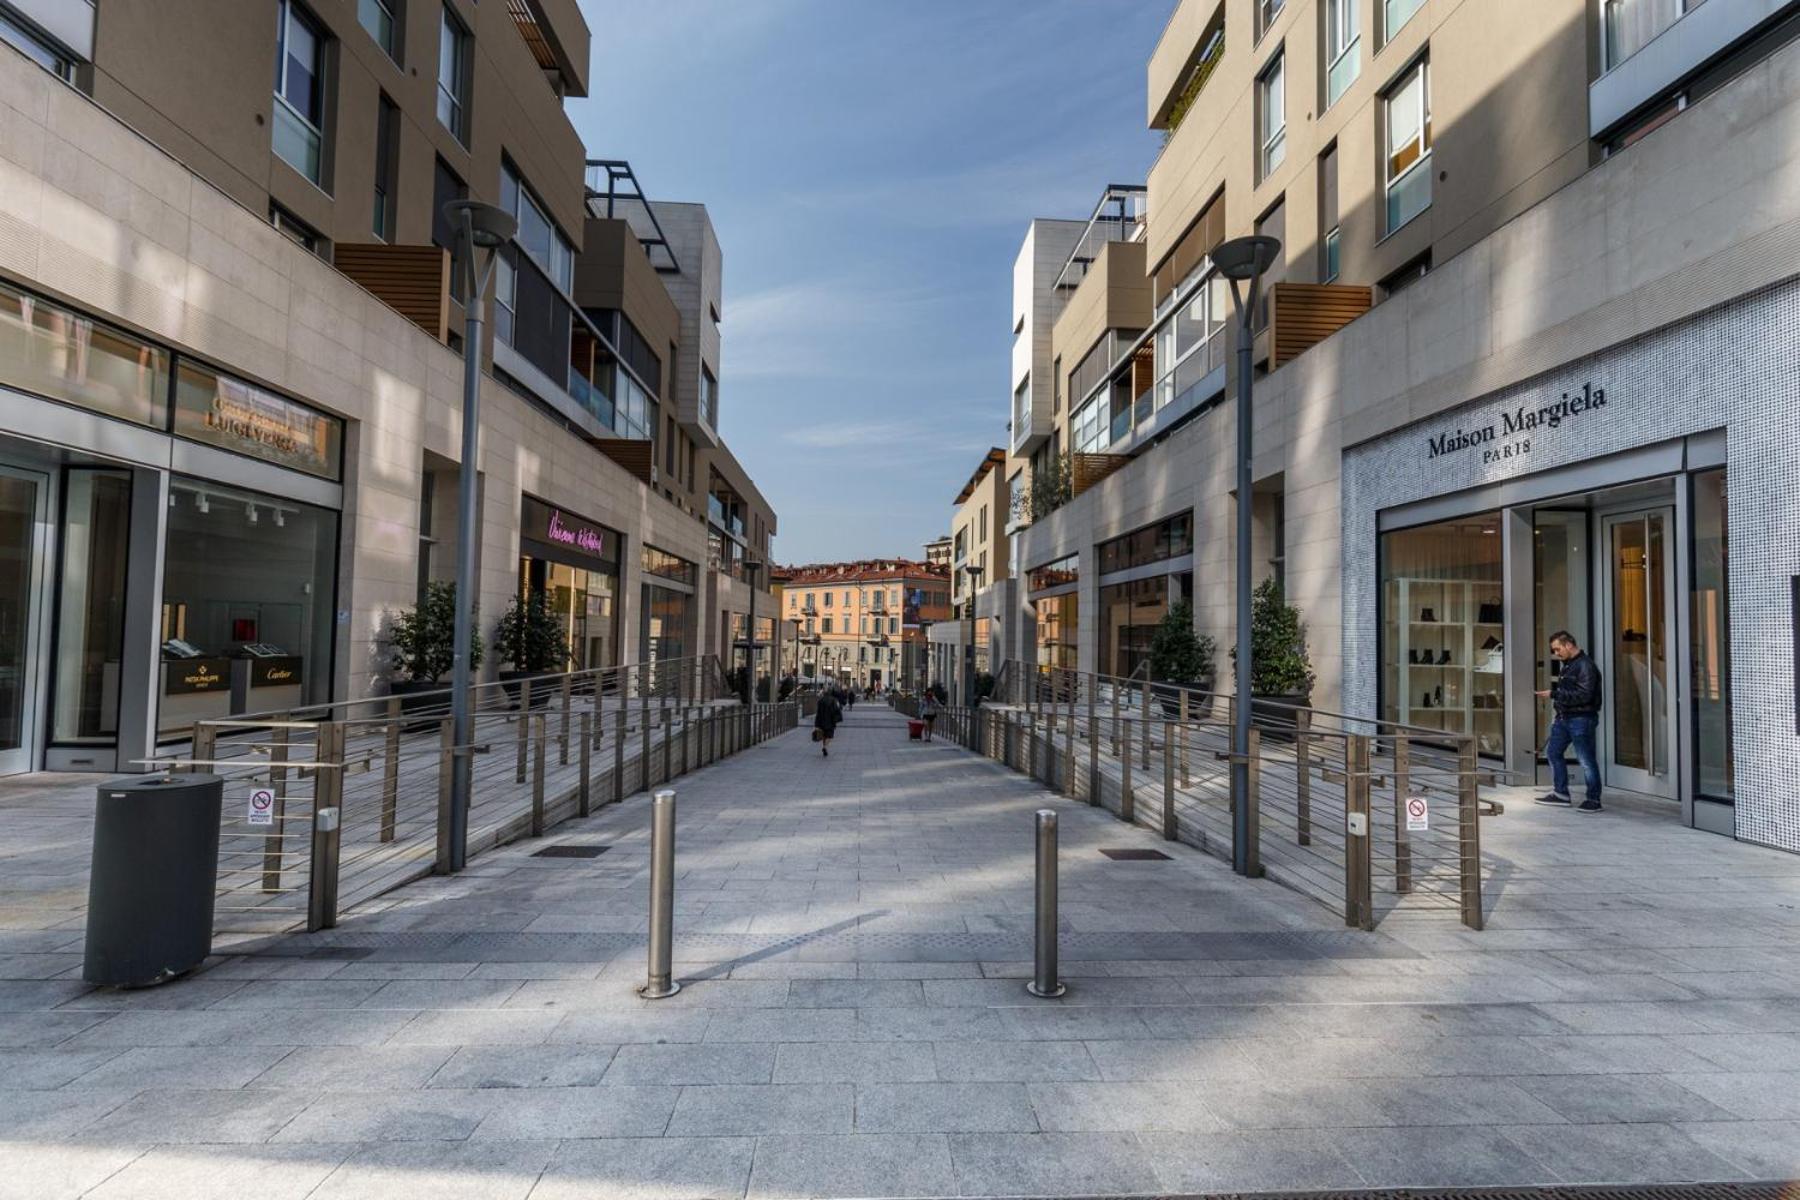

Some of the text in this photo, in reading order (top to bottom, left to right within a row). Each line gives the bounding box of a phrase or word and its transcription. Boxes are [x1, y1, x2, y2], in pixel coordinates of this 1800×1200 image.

[1428, 382, 1607, 459] Maison Margiela
[1483, 440, 1530, 464] PARIS
[267, 668, 292, 680] Cartier
